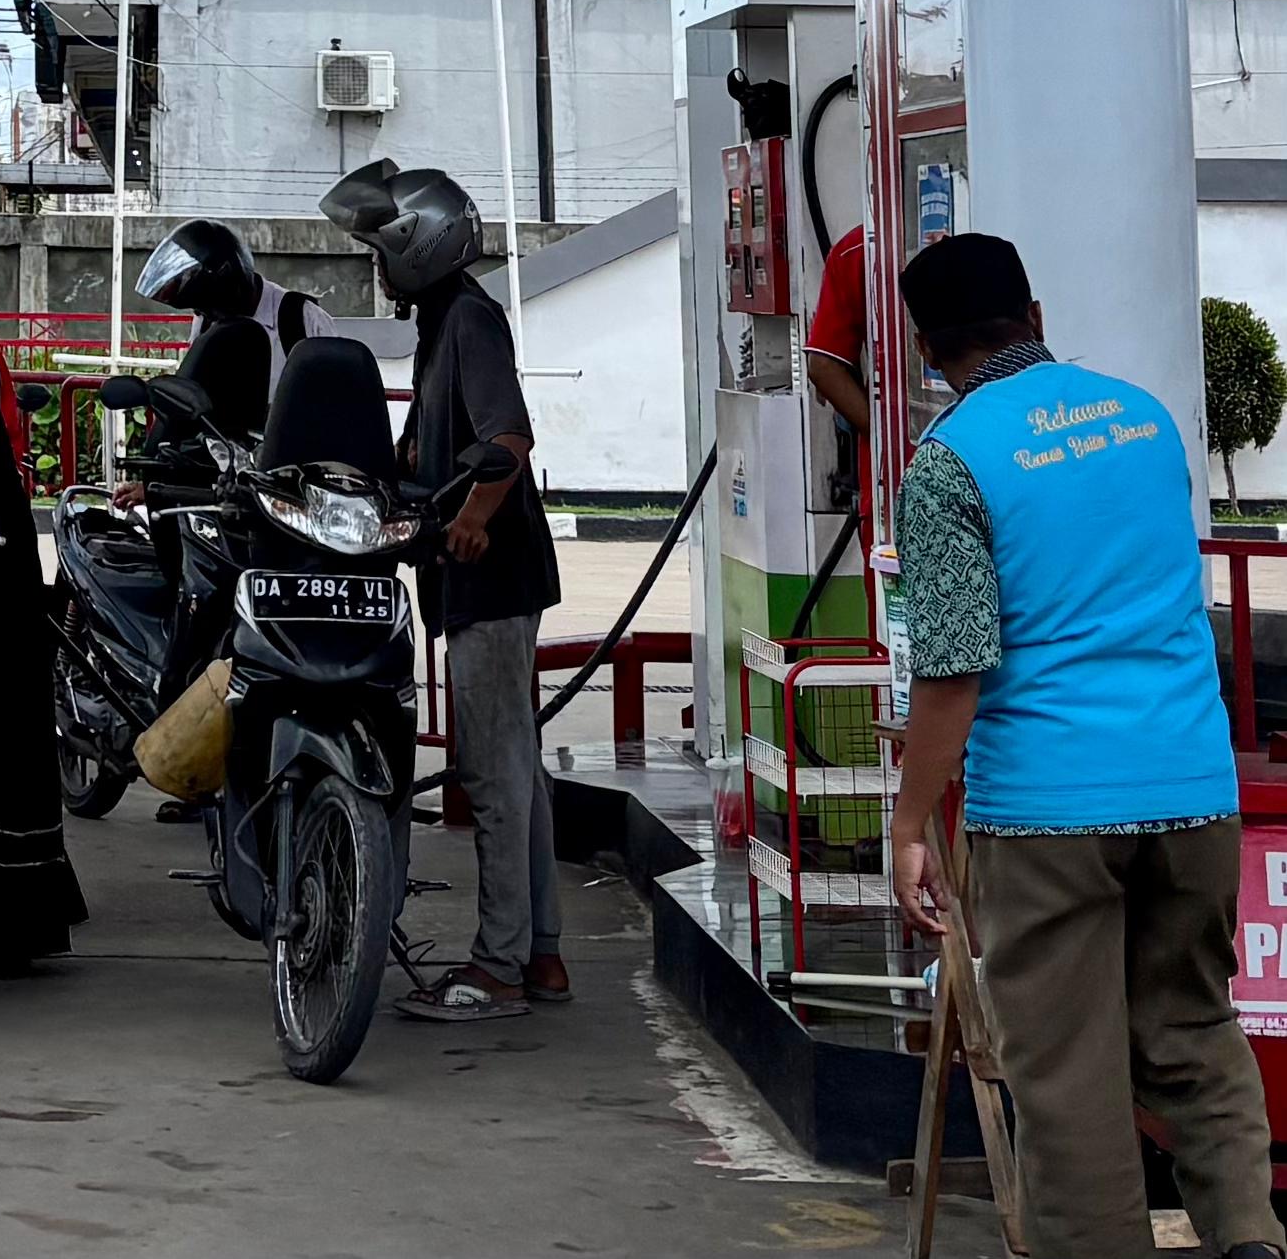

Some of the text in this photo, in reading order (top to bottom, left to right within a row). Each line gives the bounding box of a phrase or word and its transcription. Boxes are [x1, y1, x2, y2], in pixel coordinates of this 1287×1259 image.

[254, 578, 389, 600] DA 2894 VL
